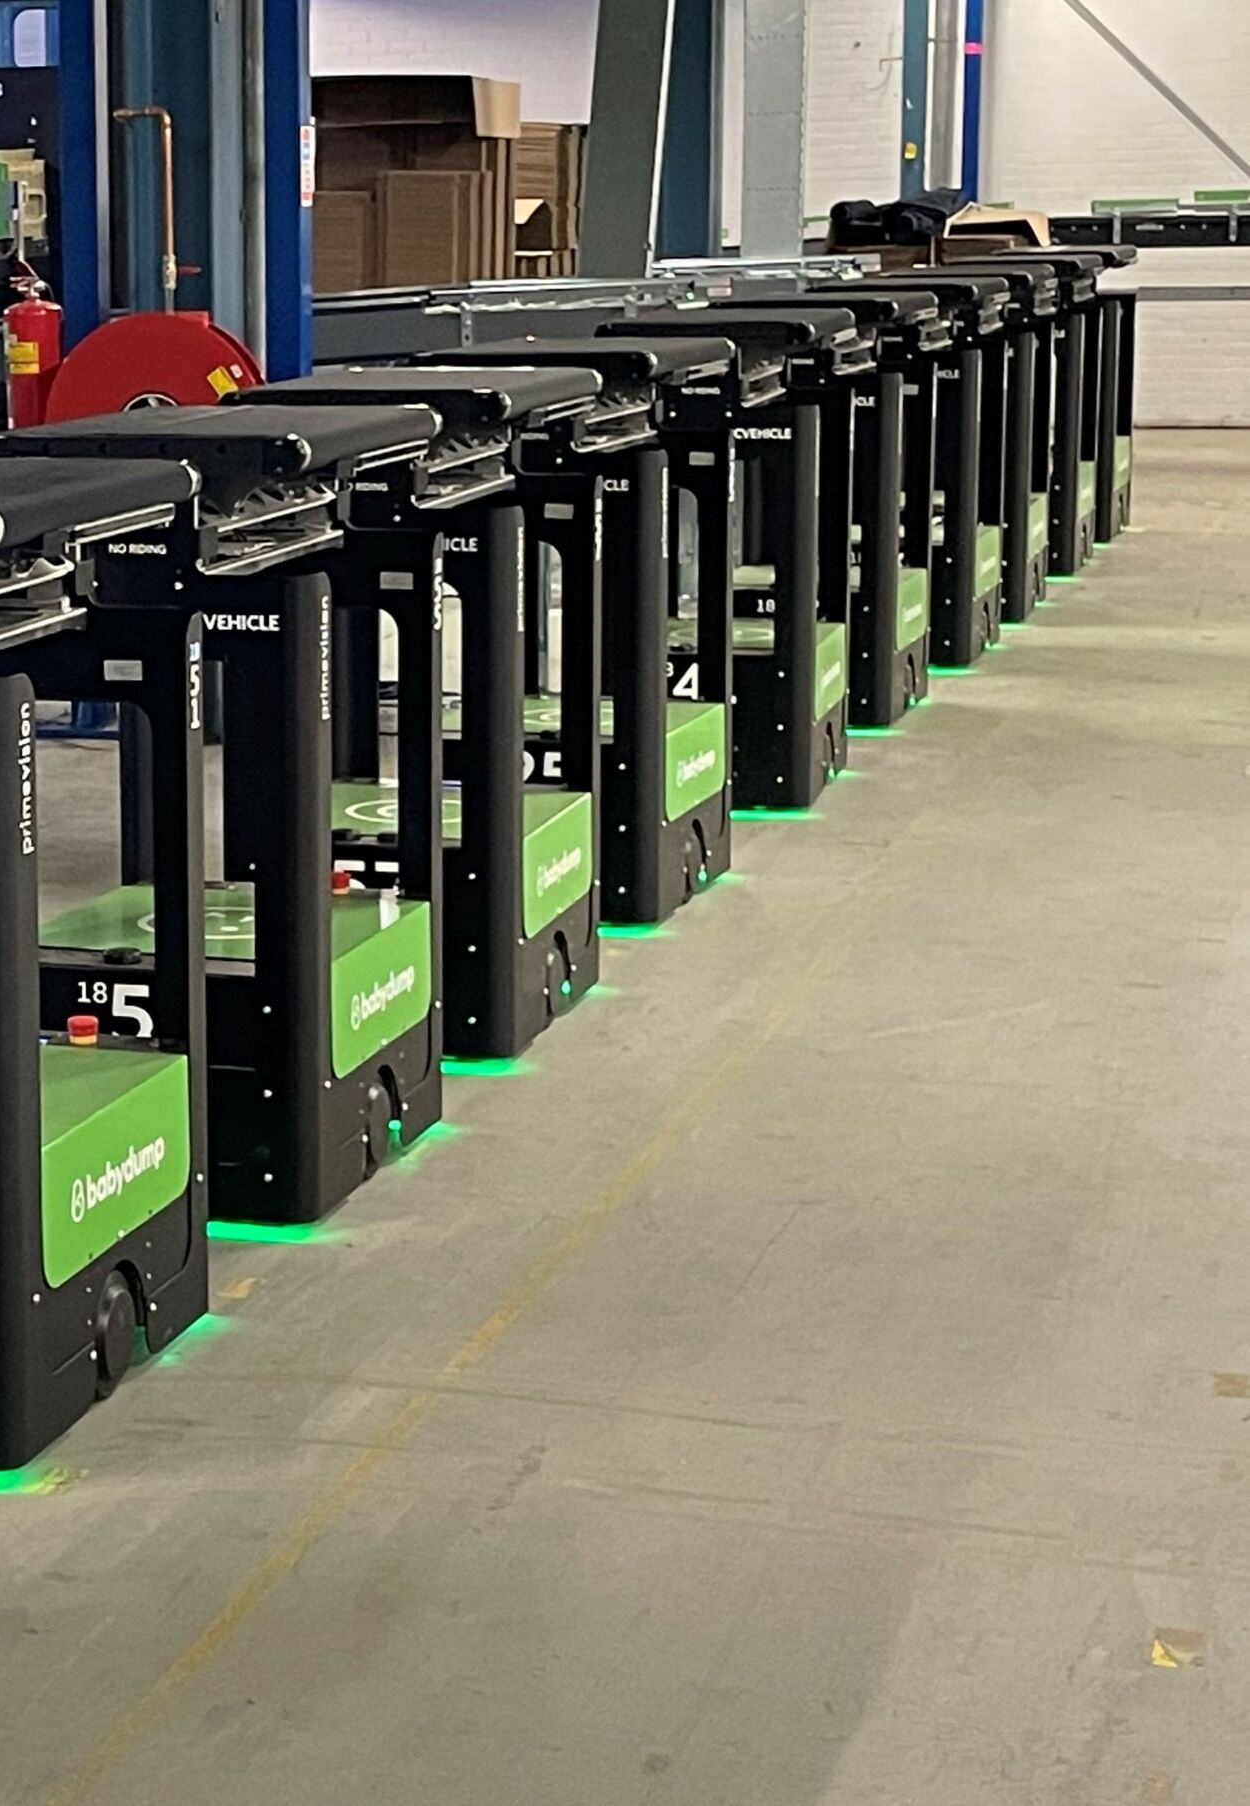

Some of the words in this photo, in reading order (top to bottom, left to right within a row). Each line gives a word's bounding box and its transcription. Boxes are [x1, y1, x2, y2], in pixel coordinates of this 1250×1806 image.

[108, 543, 127, 554] NO
[17, 702, 36, 855] primevision
[77, 981, 108, 1004] 18
[86, 1136, 165, 1210] babydump
